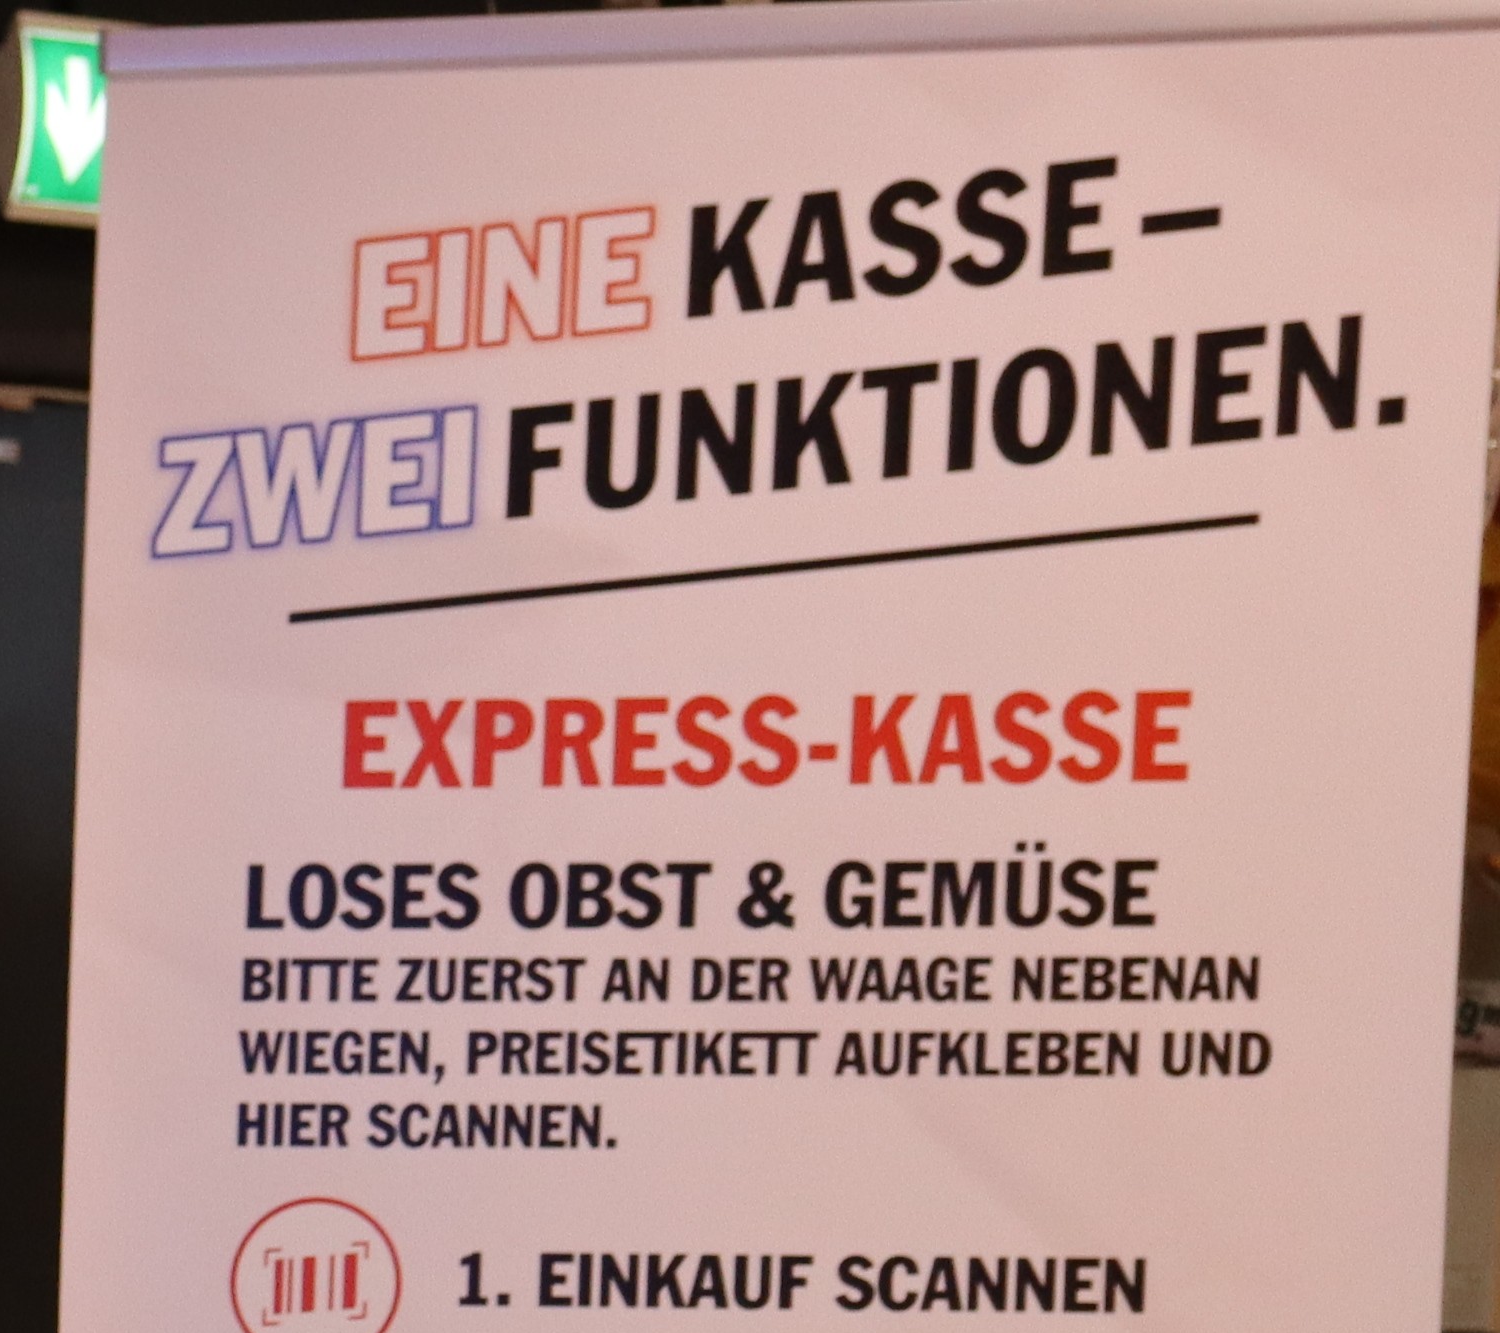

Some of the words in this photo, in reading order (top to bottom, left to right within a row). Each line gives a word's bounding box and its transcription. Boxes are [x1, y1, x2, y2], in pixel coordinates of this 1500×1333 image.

[350, 207, 656, 361] EINE
[686, 155, 1119, 319] KASSE
[151, 404, 478, 558] ZWEI
[504, 315, 1408, 520] FUNKTIONEN.
[343, 689, 1193, 789] EXPRESS-KASSE
[246, 862, 481, 931] LOSES
[509, 861, 713, 930] OBST
[737, 860, 796, 930] &
[824, 841, 1158, 929] GEMÜSE
[242, 958, 379, 1002] BITTE
[395, 957, 587, 1003] ZUERST
[602, 958, 670, 1002] AN
[691, 957, 791, 1003] DER
[809, 956, 993, 1003] WAAGE
[1012, 956, 1260, 1002] NEBENAN
[239, 1030, 445, 1084] WIEGEN,
[467, 1030, 820, 1076] PREISETIKETT
[835, 1031, 1140, 1077] AUFKLEBEN
[1162, 1031, 1272, 1077] UND
[237, 1103, 350, 1147] HIER
[367, 1103, 617, 1149] SCANNEN.
[459, 1252, 510, 1306] 1.
[539, 1253, 814, 1310] EINKAUF
[835, 1255, 1147, 1313] SCANNEN
